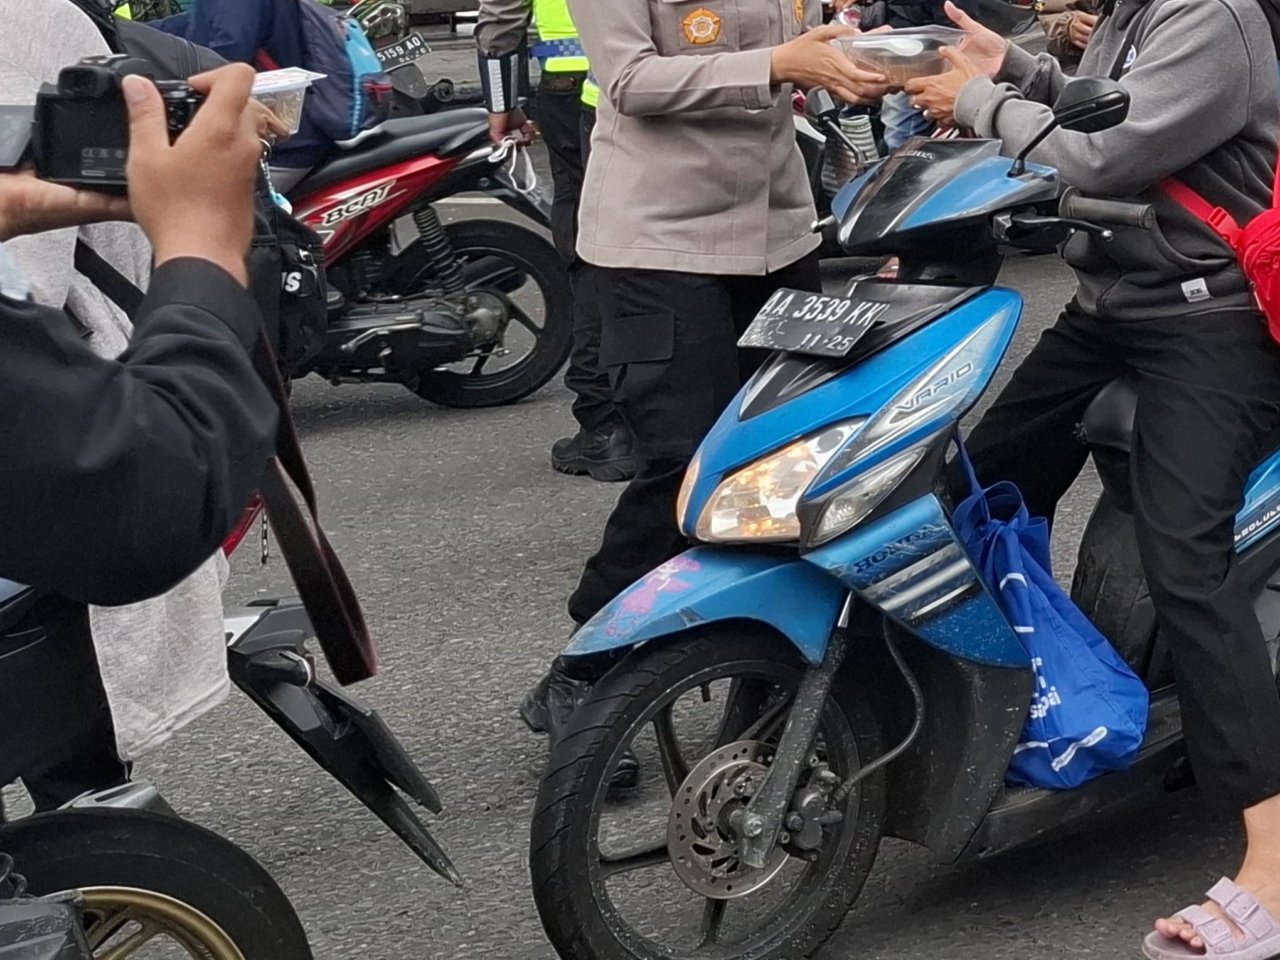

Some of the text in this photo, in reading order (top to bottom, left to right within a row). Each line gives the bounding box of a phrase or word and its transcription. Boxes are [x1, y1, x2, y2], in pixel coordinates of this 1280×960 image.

[377, 46, 405, 62] 5159
[758, 291, 891, 327] AA 3539 KK
[895, 361, 974, 412] VARIO
